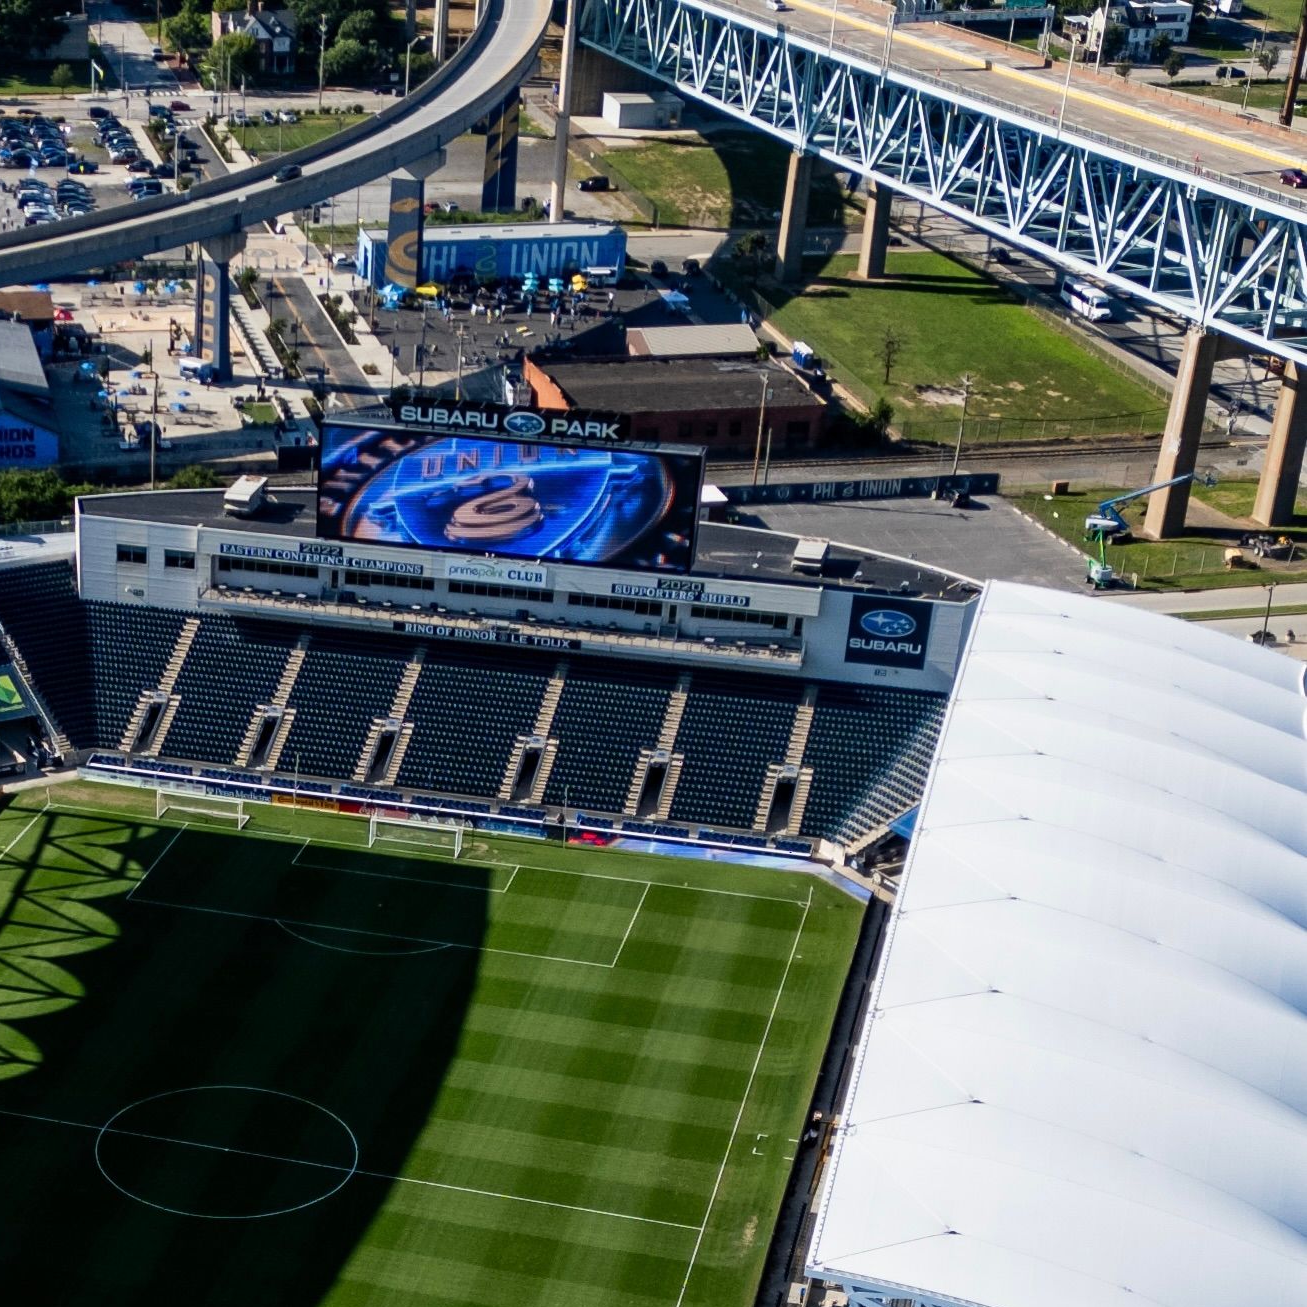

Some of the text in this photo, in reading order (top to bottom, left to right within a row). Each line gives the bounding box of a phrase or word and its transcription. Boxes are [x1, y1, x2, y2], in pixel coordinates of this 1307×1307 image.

[400, 405, 621, 440] SUBARU PARK
[812, 478, 902, 499] PHL UNION
[302, 543, 341, 555] 2022
[222, 543, 423, 575] EASTERN CONFERENCE CHAMPIONS
[507, 569, 543, 583] CLUB
[660, 579, 702, 592] 2020
[700, 591, 747, 607] SHIELD
[404, 622, 434, 635] RING
[436, 625, 452, 637] OF
[454, 627, 497, 641] HONOR
[849, 637, 922, 655] SUBARU
